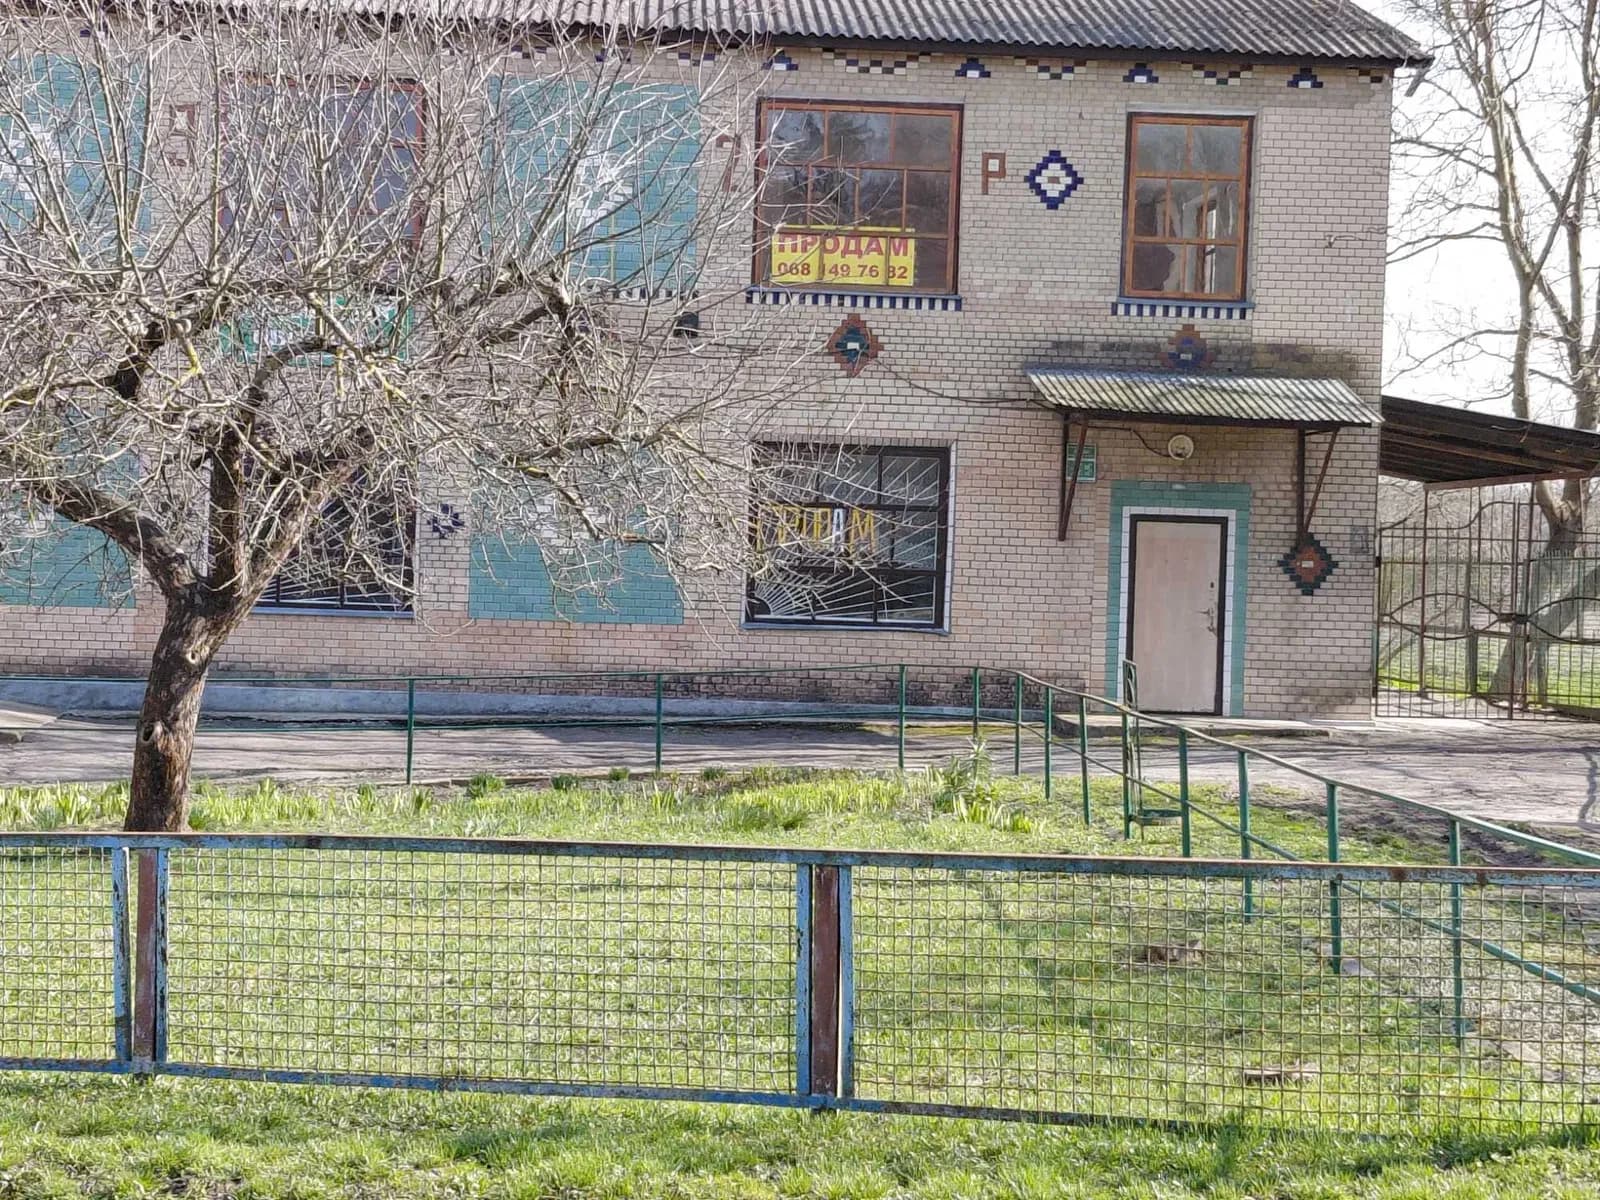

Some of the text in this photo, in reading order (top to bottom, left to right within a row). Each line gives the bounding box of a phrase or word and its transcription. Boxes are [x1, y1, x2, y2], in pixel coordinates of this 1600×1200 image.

[777, 233, 909, 258] ПРОДАМ
[777, 262, 811, 276] 068
[858, 265, 879, 278] 76
